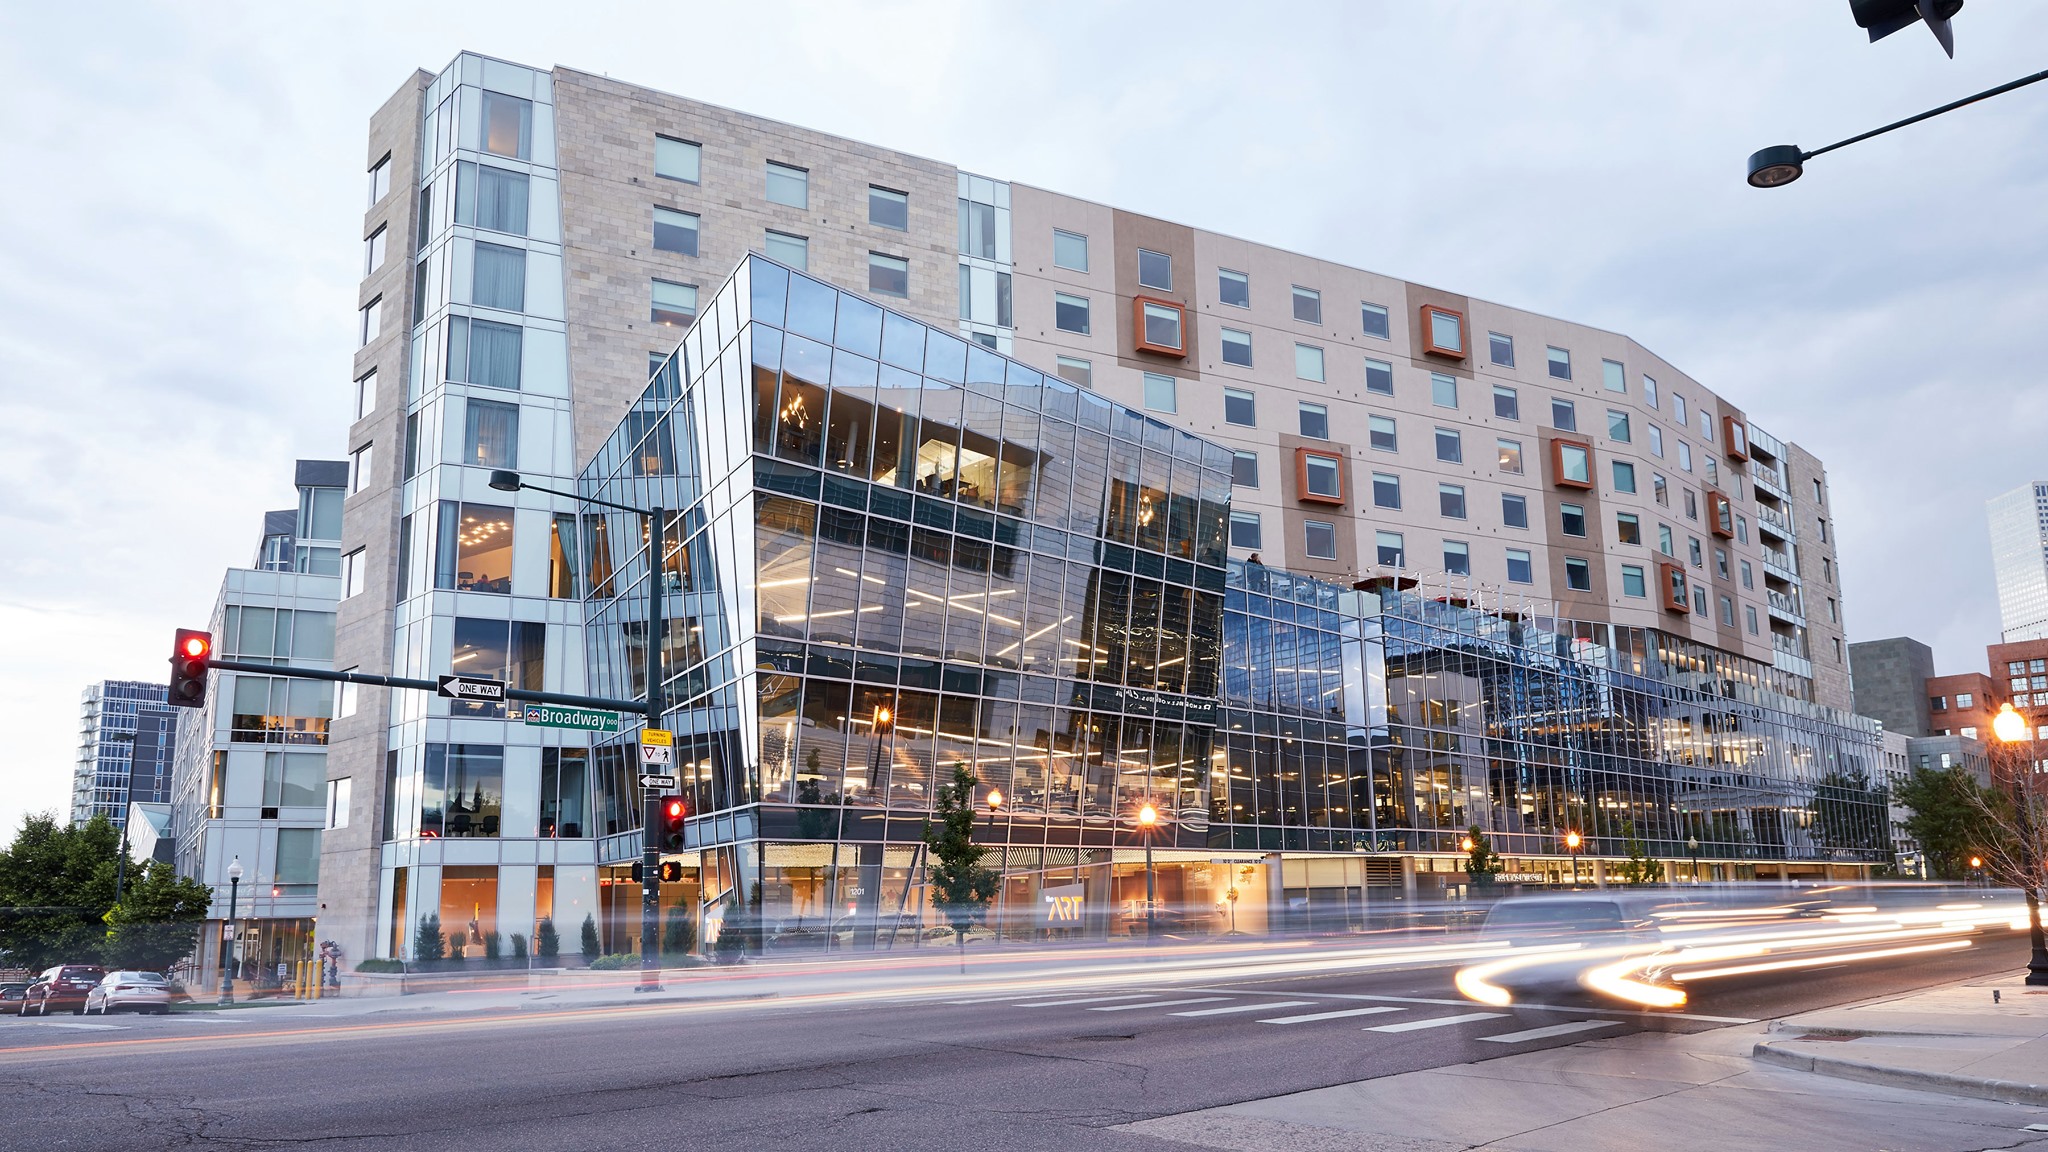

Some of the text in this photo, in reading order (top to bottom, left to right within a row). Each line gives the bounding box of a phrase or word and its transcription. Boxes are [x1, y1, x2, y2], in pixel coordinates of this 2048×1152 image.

[459, 684, 499, 696] ONE WAY
[541, 708, 607, 730] Broadway
[850, 887, 865, 895] 1201
[1048, 896, 1083, 921] ART
